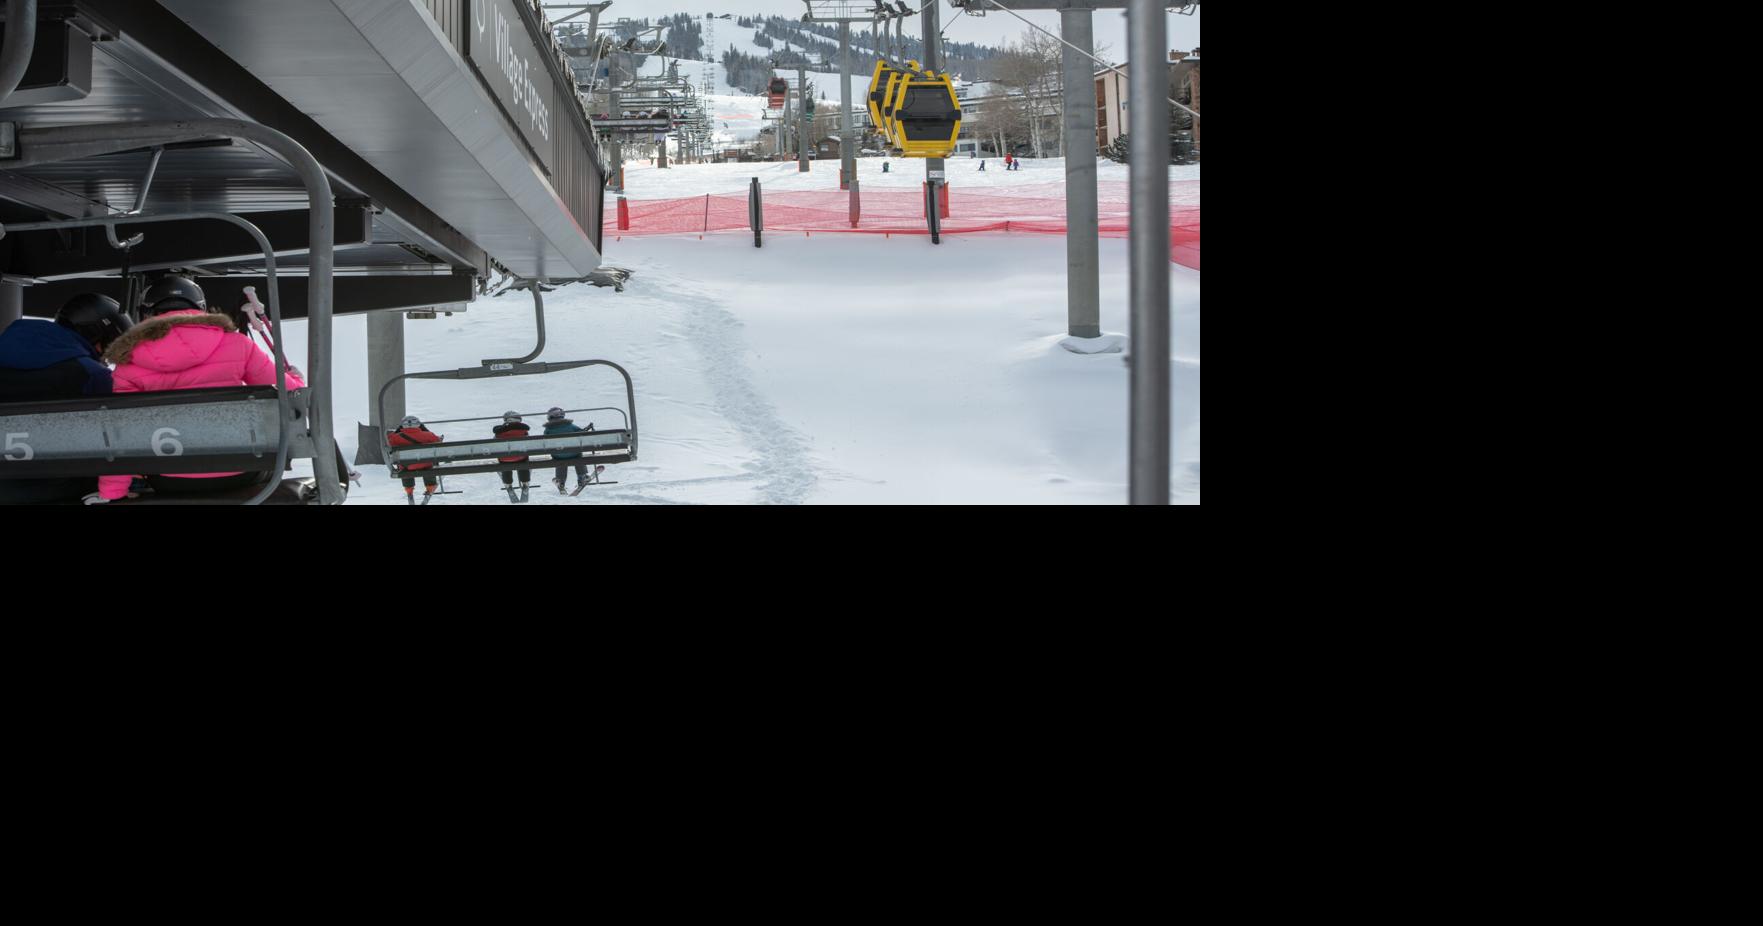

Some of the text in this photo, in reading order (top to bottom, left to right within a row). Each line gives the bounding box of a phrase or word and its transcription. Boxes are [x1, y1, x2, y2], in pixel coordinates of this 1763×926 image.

[494, 3, 549, 141] Village Express
[4, 432, 34, 461] 5
[151, 427, 184, 456] 6
